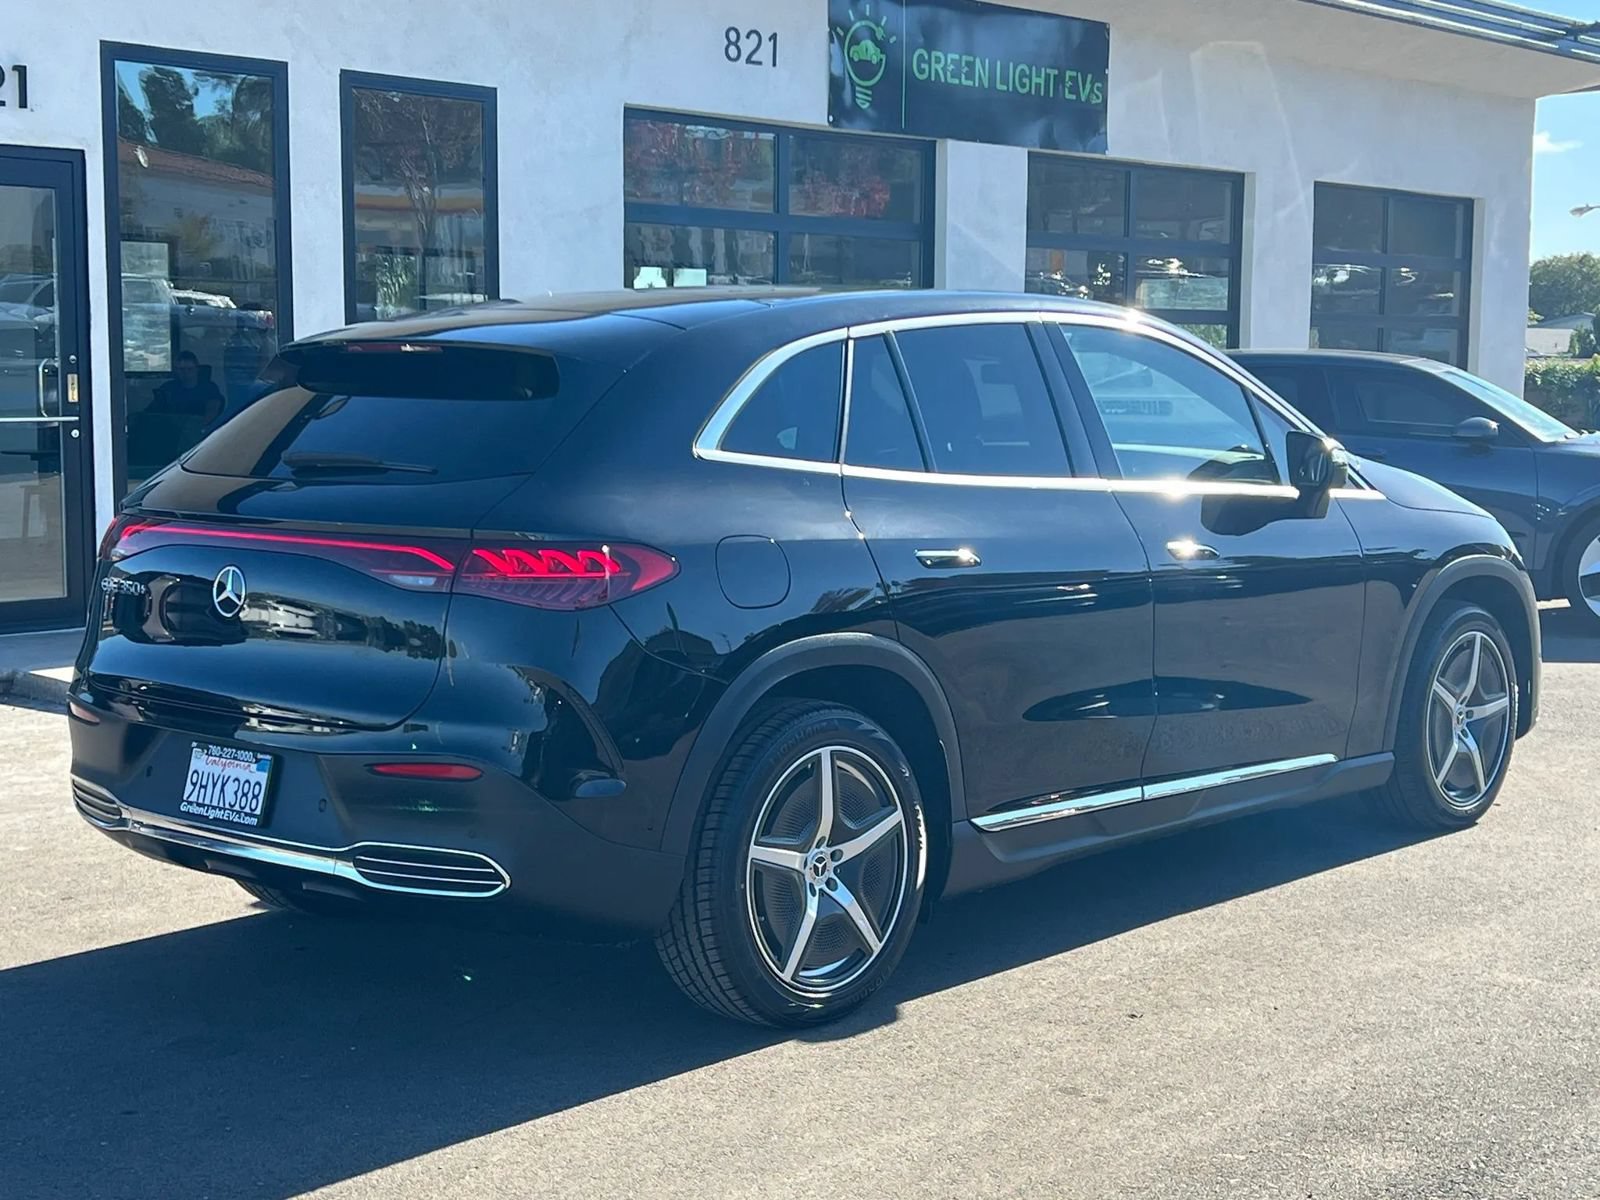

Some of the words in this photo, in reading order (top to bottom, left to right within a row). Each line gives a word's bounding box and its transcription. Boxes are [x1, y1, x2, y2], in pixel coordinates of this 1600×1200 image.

[724, 26, 778, 67] 821
[912, 48, 989, 89] GREEN
[995, 60, 1058, 97] LIGHT
[1064, 70, 1103, 104] EVs
[186, 769, 262, 812] 9HYK388
